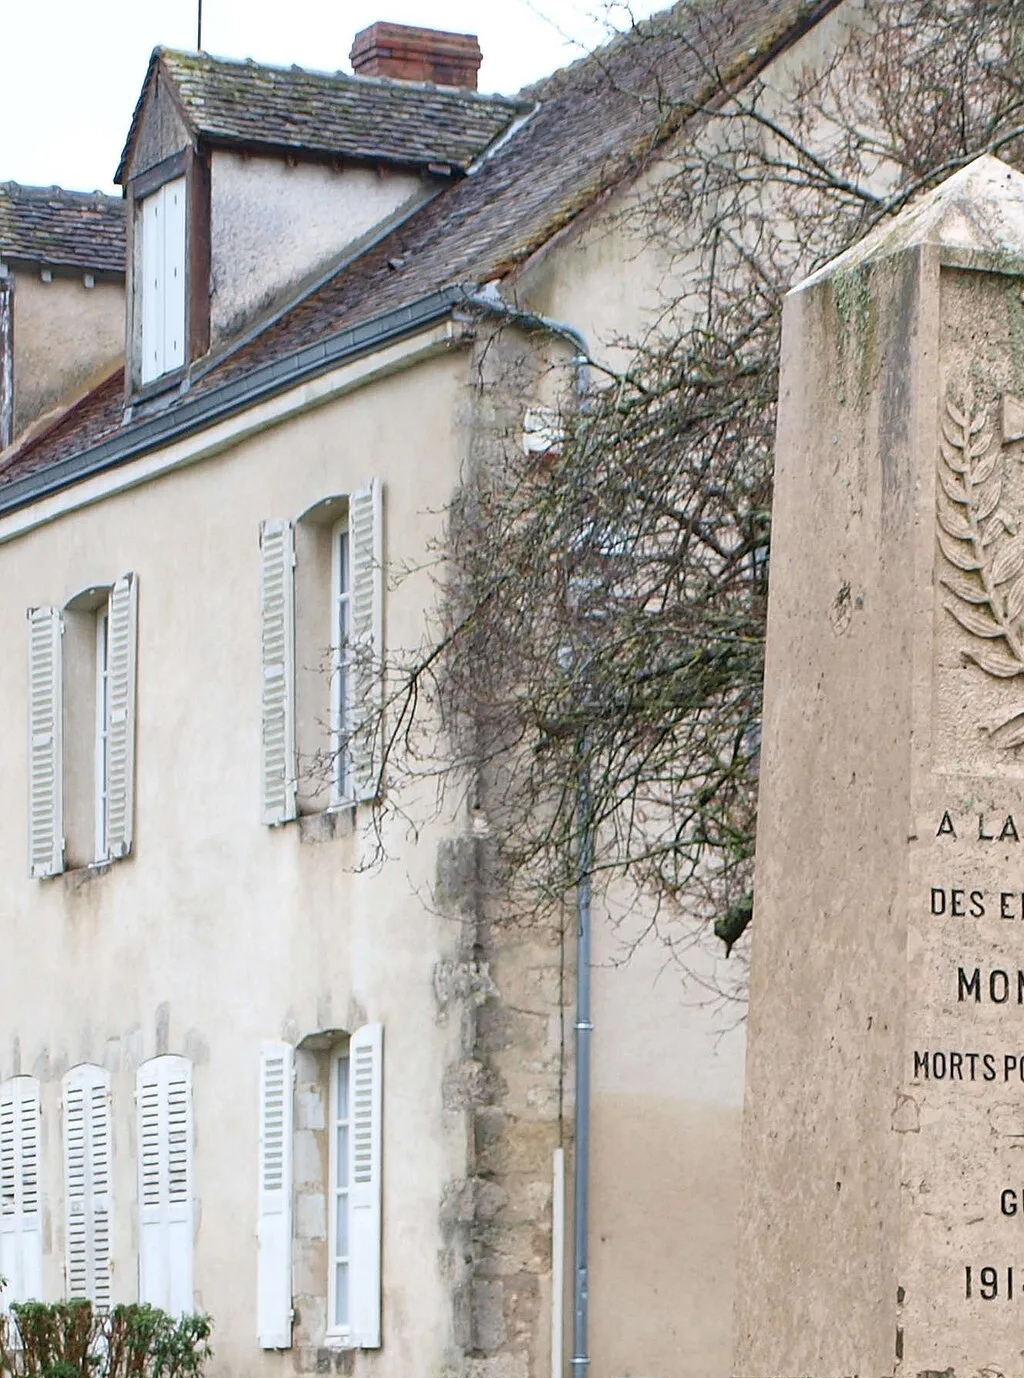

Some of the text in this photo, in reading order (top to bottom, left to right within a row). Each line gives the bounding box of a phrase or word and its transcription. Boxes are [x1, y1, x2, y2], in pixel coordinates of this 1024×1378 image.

[936, 810, 957, 840] A
[977, 813, 1020, 843] LA
[930, 887, 985, 918] DES
[913, 1051, 996, 1083] MORTS
